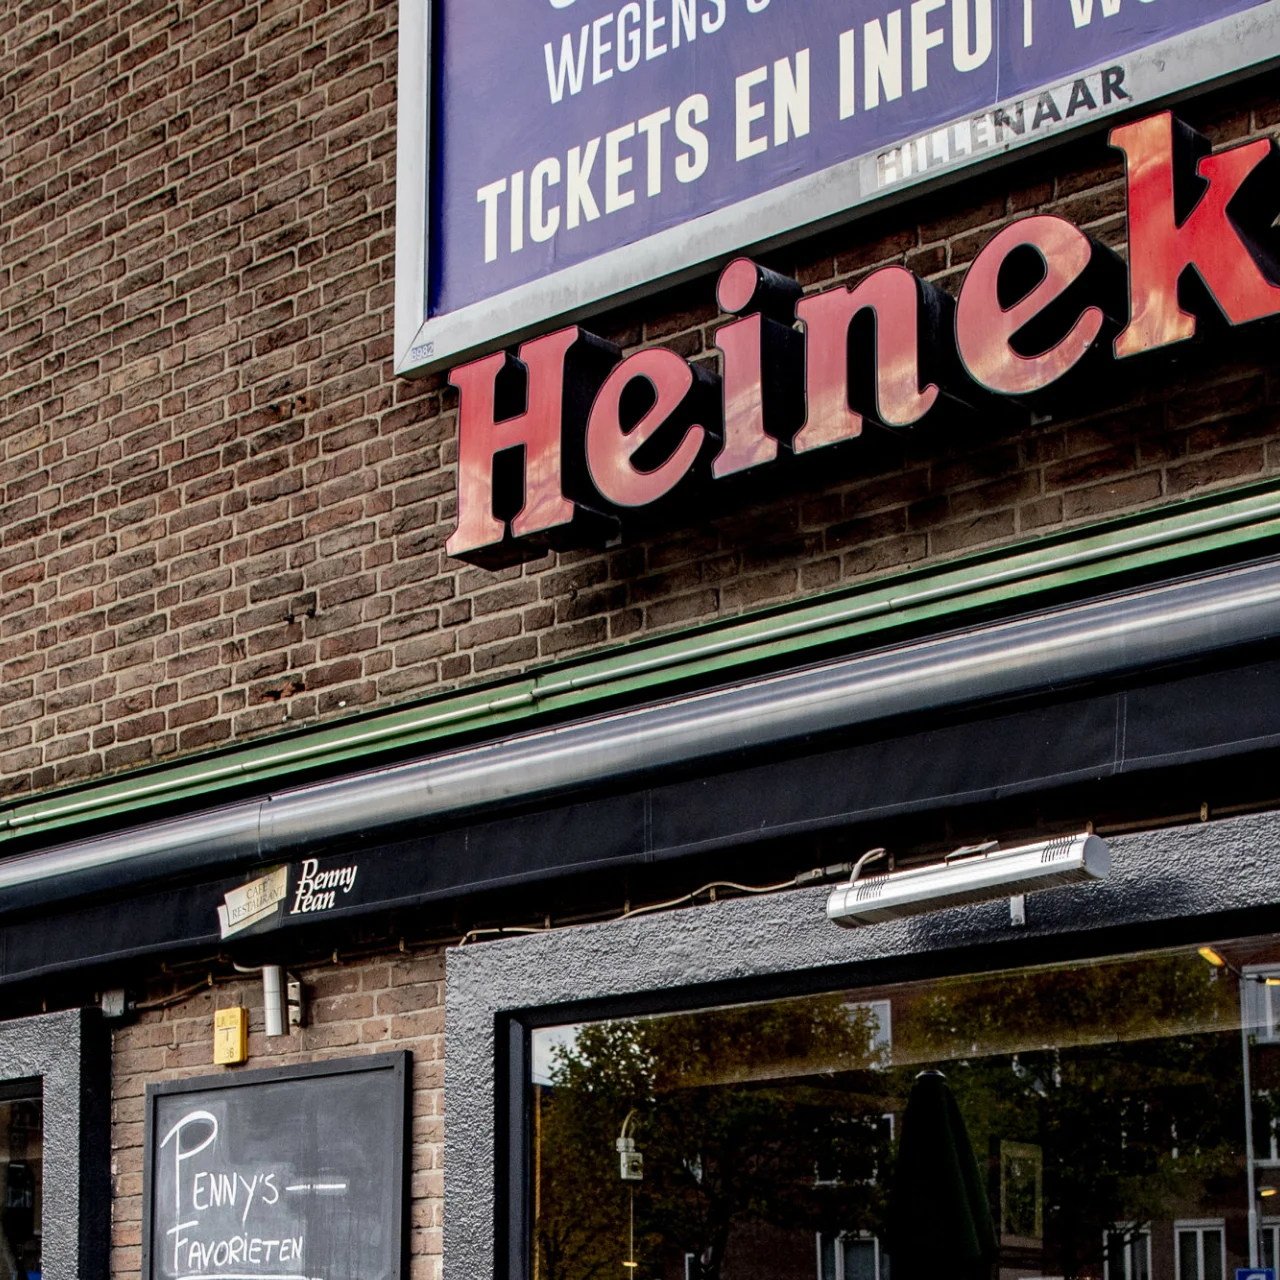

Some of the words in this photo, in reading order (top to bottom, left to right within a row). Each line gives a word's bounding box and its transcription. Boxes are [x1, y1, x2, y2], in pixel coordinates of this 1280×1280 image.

[477, 92, 710, 262] TICKETS
[735, 47, 811, 163] EN
[231, 884, 285, 921] RESTAURANT
[297, 858, 358, 894] Penny
[160, 1110, 280, 1223] PENNY'S
[166, 1219, 304, 1273] FAVORIETEN
